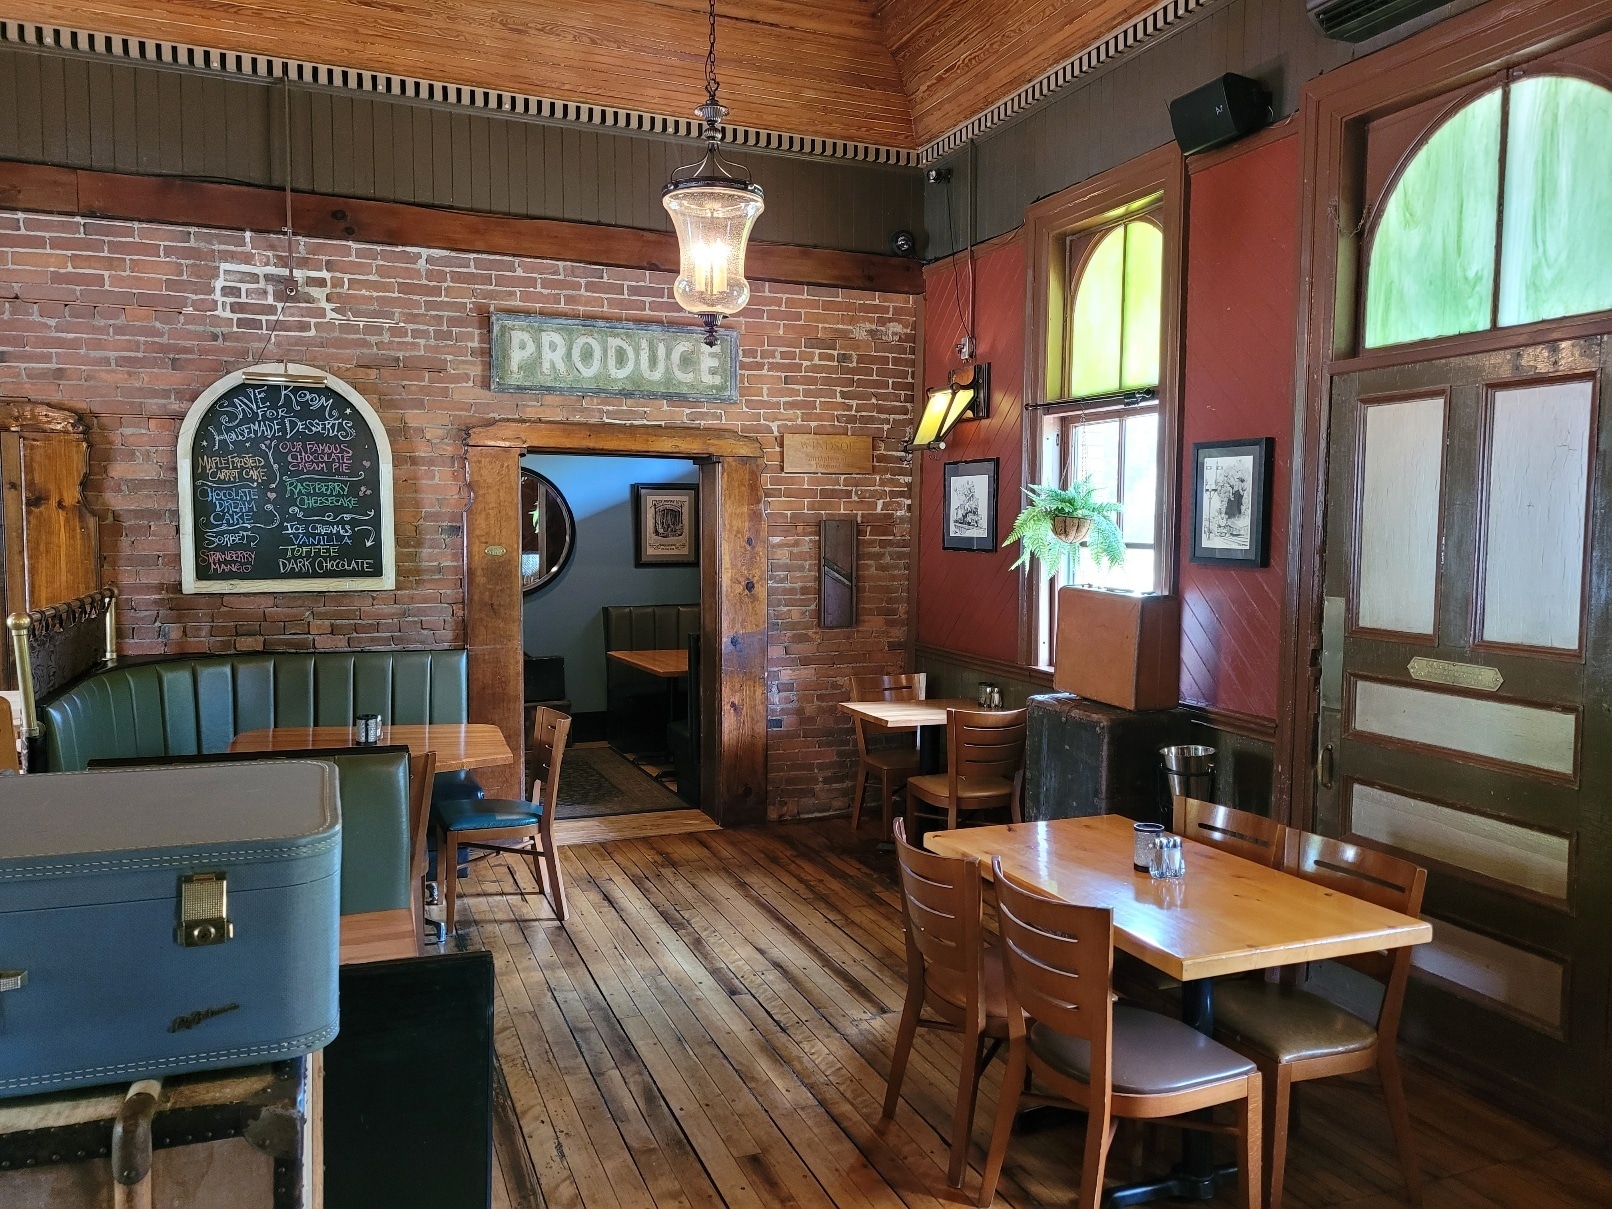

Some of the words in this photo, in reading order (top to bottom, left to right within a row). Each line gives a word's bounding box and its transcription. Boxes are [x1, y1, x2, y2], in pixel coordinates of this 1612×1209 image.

[508, 329, 722, 385] PRODUCE
[214, 386, 270, 427] SAVE
[278, 384, 339, 421] ROOM
[257, 407, 294, 420] FOR
[208, 419, 282, 451] HOUSEMADE
[285, 417, 356, 441] DESSERTS
[279, 441, 304, 454] OUR
[306, 441, 353, 457] FAMOUS
[197, 455, 229, 473] MAPLE
[228, 453, 265, 469] FROSTED
[288, 452, 353, 464] CHOCOLATE
[289, 462, 329, 473] CREAM
[332, 463, 351, 473] PIE
[208, 468, 240, 481] CARROT
[242, 468, 267, 482] CAKE
[198, 486, 258, 503] CHOCOLATE
[285, 480, 350, 498] RASPBERRY
[215, 500, 257, 513] DREAM
[297, 495, 359, 508] CHEESECAKE
[210, 512, 253, 525] CAKE
[282, 521, 306, 533] ICE
[308, 524, 352, 535] CREAMS
[203, 531, 251, 548] SORBET
[289, 534, 352, 545] VANILLA
[199, 550, 256, 565] STRAWBERRY
[279, 545, 339, 558] TOFFEE
[209, 562, 252, 574] MANGO
[279, 558, 312, 574] DARK
[315, 558, 374, 573] CHOCOLATE
